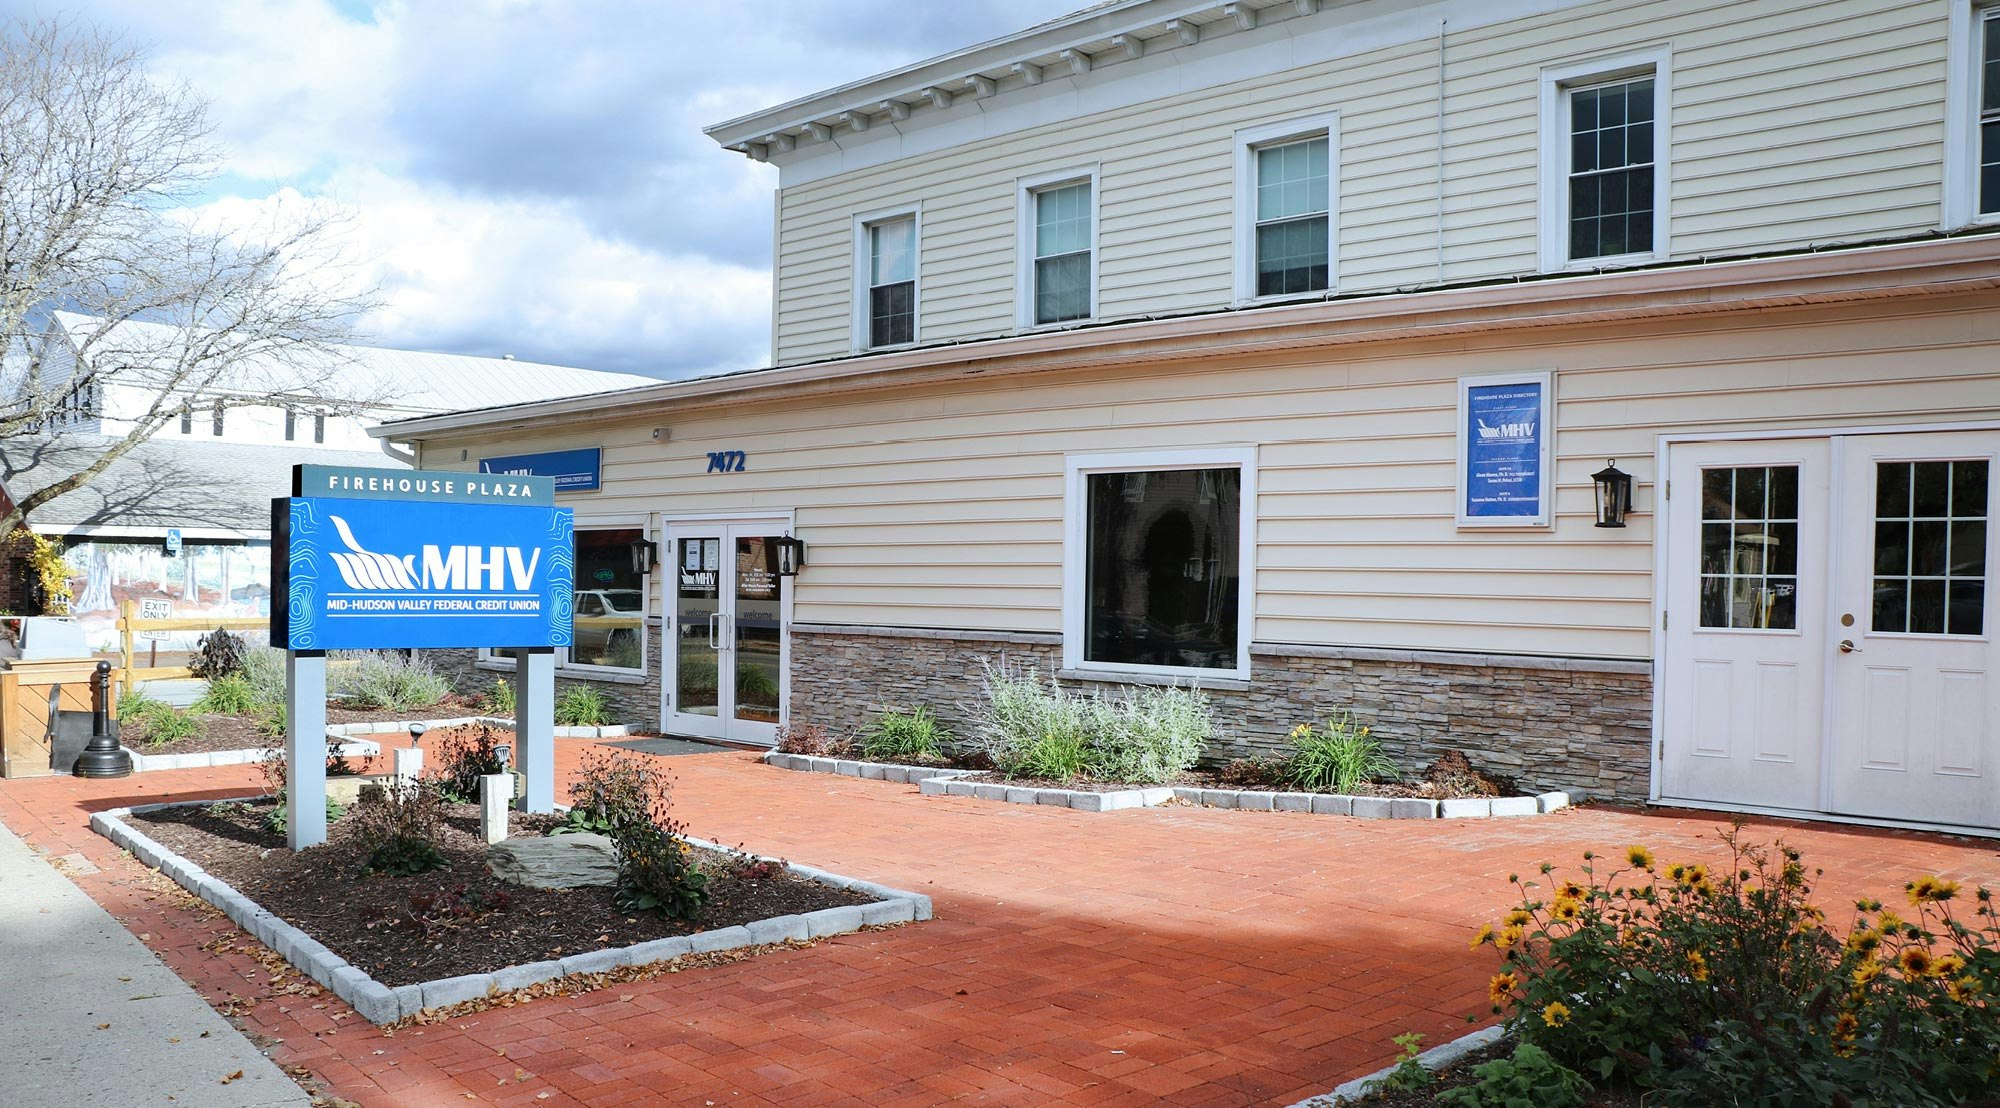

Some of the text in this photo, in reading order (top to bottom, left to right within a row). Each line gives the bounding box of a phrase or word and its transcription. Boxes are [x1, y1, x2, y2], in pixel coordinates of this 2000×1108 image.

[1501, 422, 1535, 437] MHV
[707, 451, 745, 473] 7472
[329, 475, 532, 498] FIREHOUSE PLAZA
[422, 544, 541, 591] MHV
[695, 572, 716, 585] MHV
[145, 602, 168, 611] EXIT
[327, 600, 540, 610] MID-HUDSON VALLEY FEDERAL CREDIT UNION
[143, 610, 168, 619] ONLY
[744, 610, 773, 620] welcome
